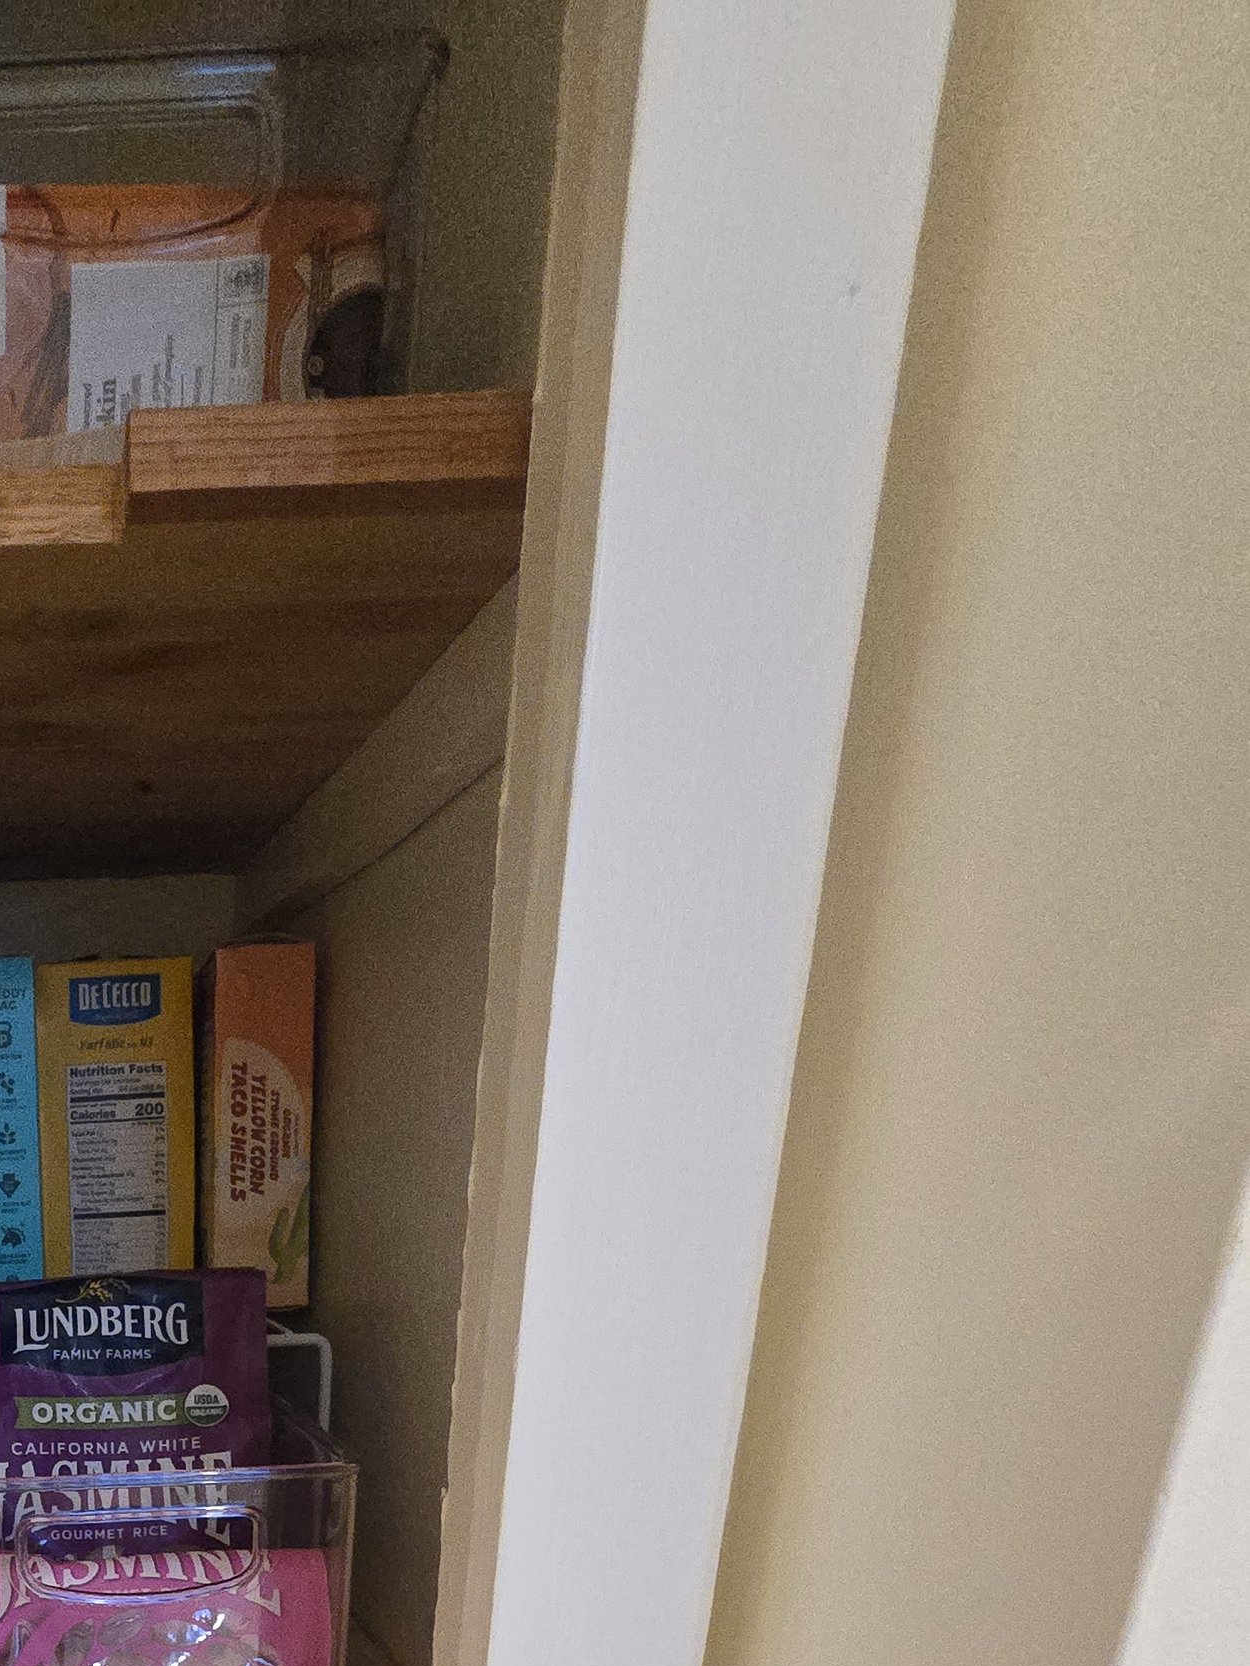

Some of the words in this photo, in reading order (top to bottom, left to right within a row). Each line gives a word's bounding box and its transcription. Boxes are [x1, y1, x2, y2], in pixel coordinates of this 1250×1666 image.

[70, 1067, 125, 1079] Nutrition
[129, 1063, 164, 1075] Facts
[230, 1061, 248, 1118] TACO
[70, 1109, 116, 1121] Calories
[135, 1102, 164, 1116] 200
[250, 1074, 267, 1143] YELLOW
[270, 1089, 281, 1129] STONE
[230, 1122, 247, 1203] SHELLS
[249, 1145, 266, 1196] CORN
[268, 1131, 280, 1181] GROUND
[13, 1302, 190, 1355] LUNDBERG
[52, 1347, 102, 1361] FAMILY
[105, 1348, 152, 1360] FARMS
[31, 1400, 177, 1424] ORGANIC
[194, 1394, 219, 1404] USDA
[11, 1441, 130, 1457] CALIFORNIA
[139, 1436, 202, 1453] WHITE
[50, 1526, 124, 1541] GOURMET
[133, 1524, 168, 1538] RICE
